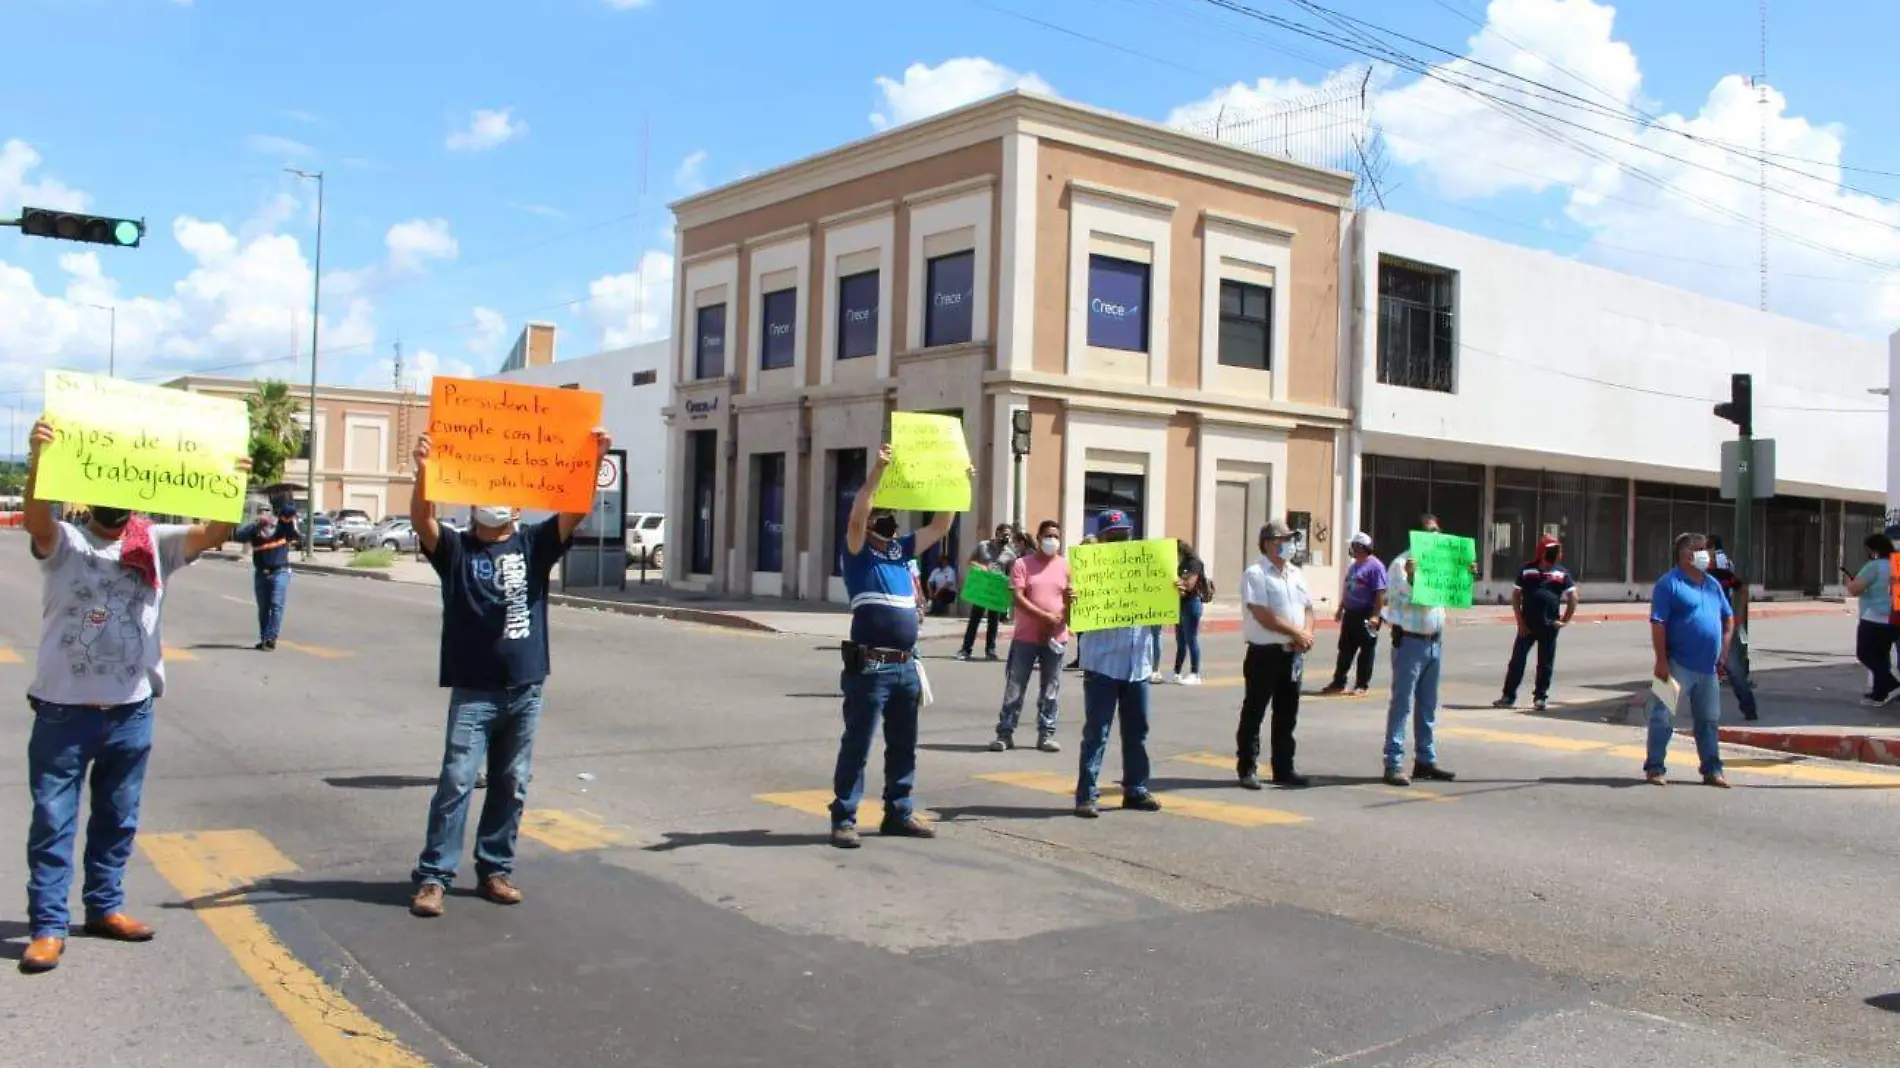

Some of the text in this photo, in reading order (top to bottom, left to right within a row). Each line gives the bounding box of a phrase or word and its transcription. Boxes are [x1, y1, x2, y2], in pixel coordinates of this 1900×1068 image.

[1091, 298, 1125, 317] Crece
[445, 384, 550, 415] Presidente
[132, 426, 161, 451] de
[504, 426, 531, 440] con
[504, 446, 519, 465] de
[556, 452, 592, 474] hijos
[80, 451, 240, 500] trabajadores
